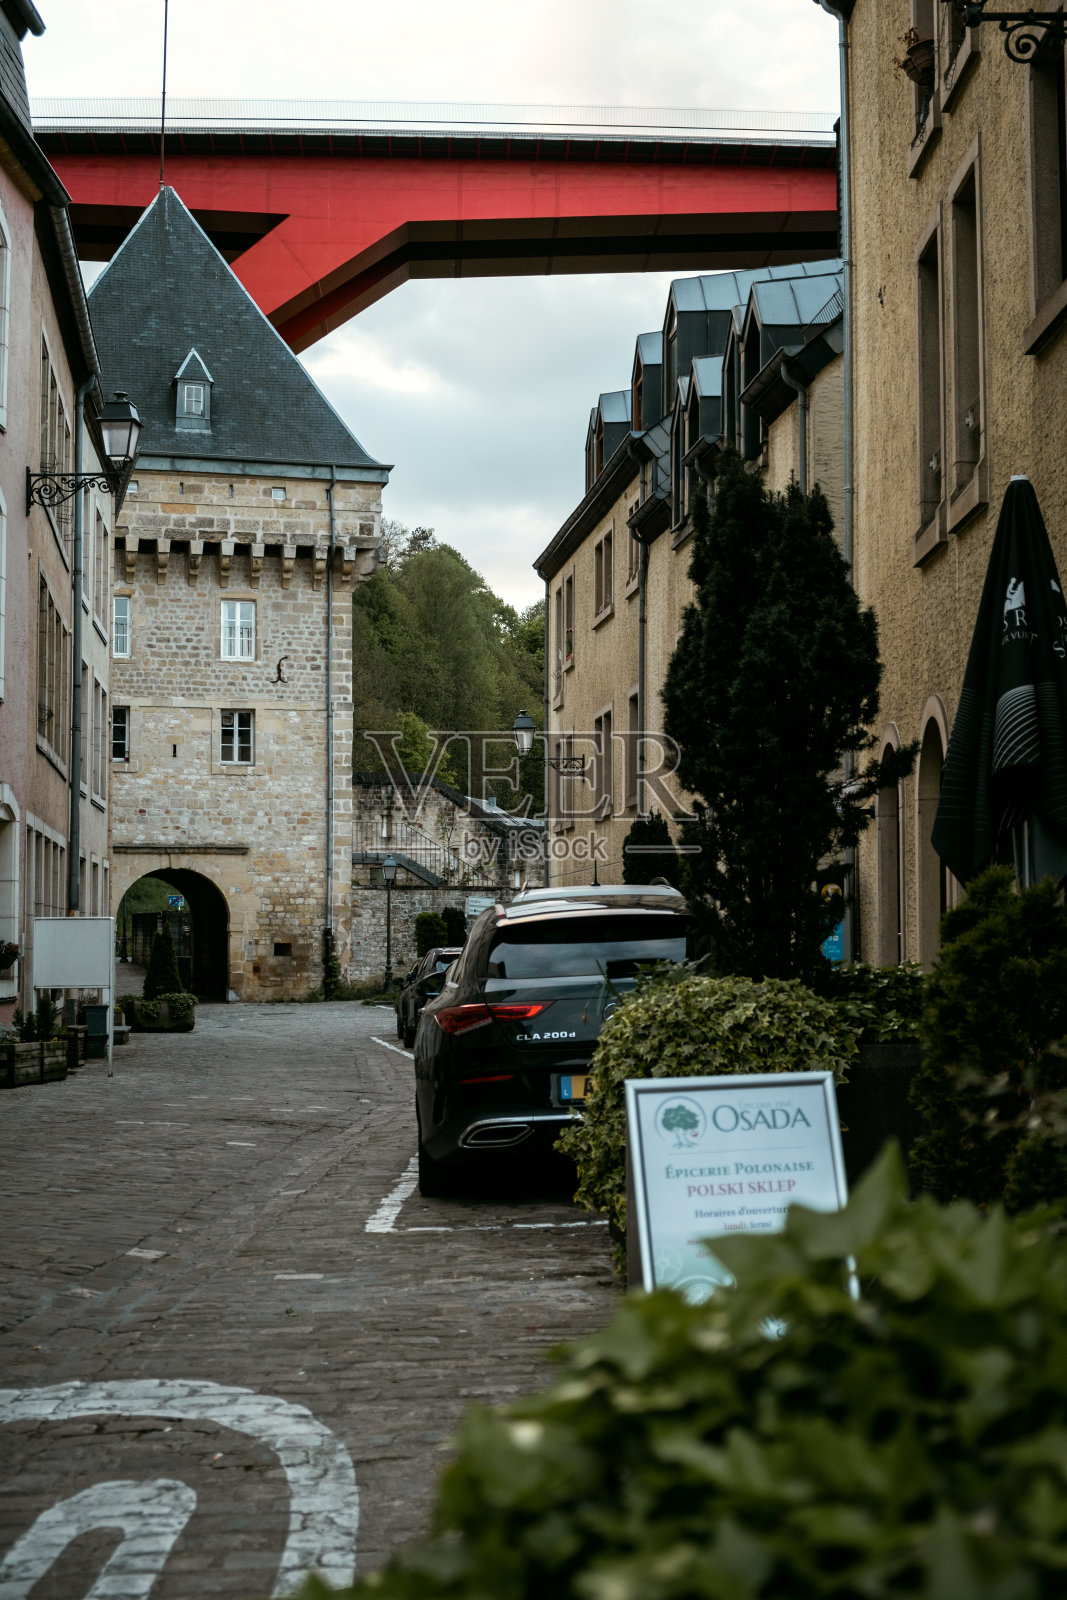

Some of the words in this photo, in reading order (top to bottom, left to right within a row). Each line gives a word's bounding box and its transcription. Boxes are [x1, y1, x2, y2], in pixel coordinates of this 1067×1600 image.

[516, 1033, 541, 1041] CLA
[712, 1106, 812, 1133] OSADA
[734, 1161, 815, 1176] POLONAISE
[687, 1182, 744, 1198] POLSKI
[748, 1180, 796, 1194] SKLEP
[694, 1208, 737, 1219] Horaires
